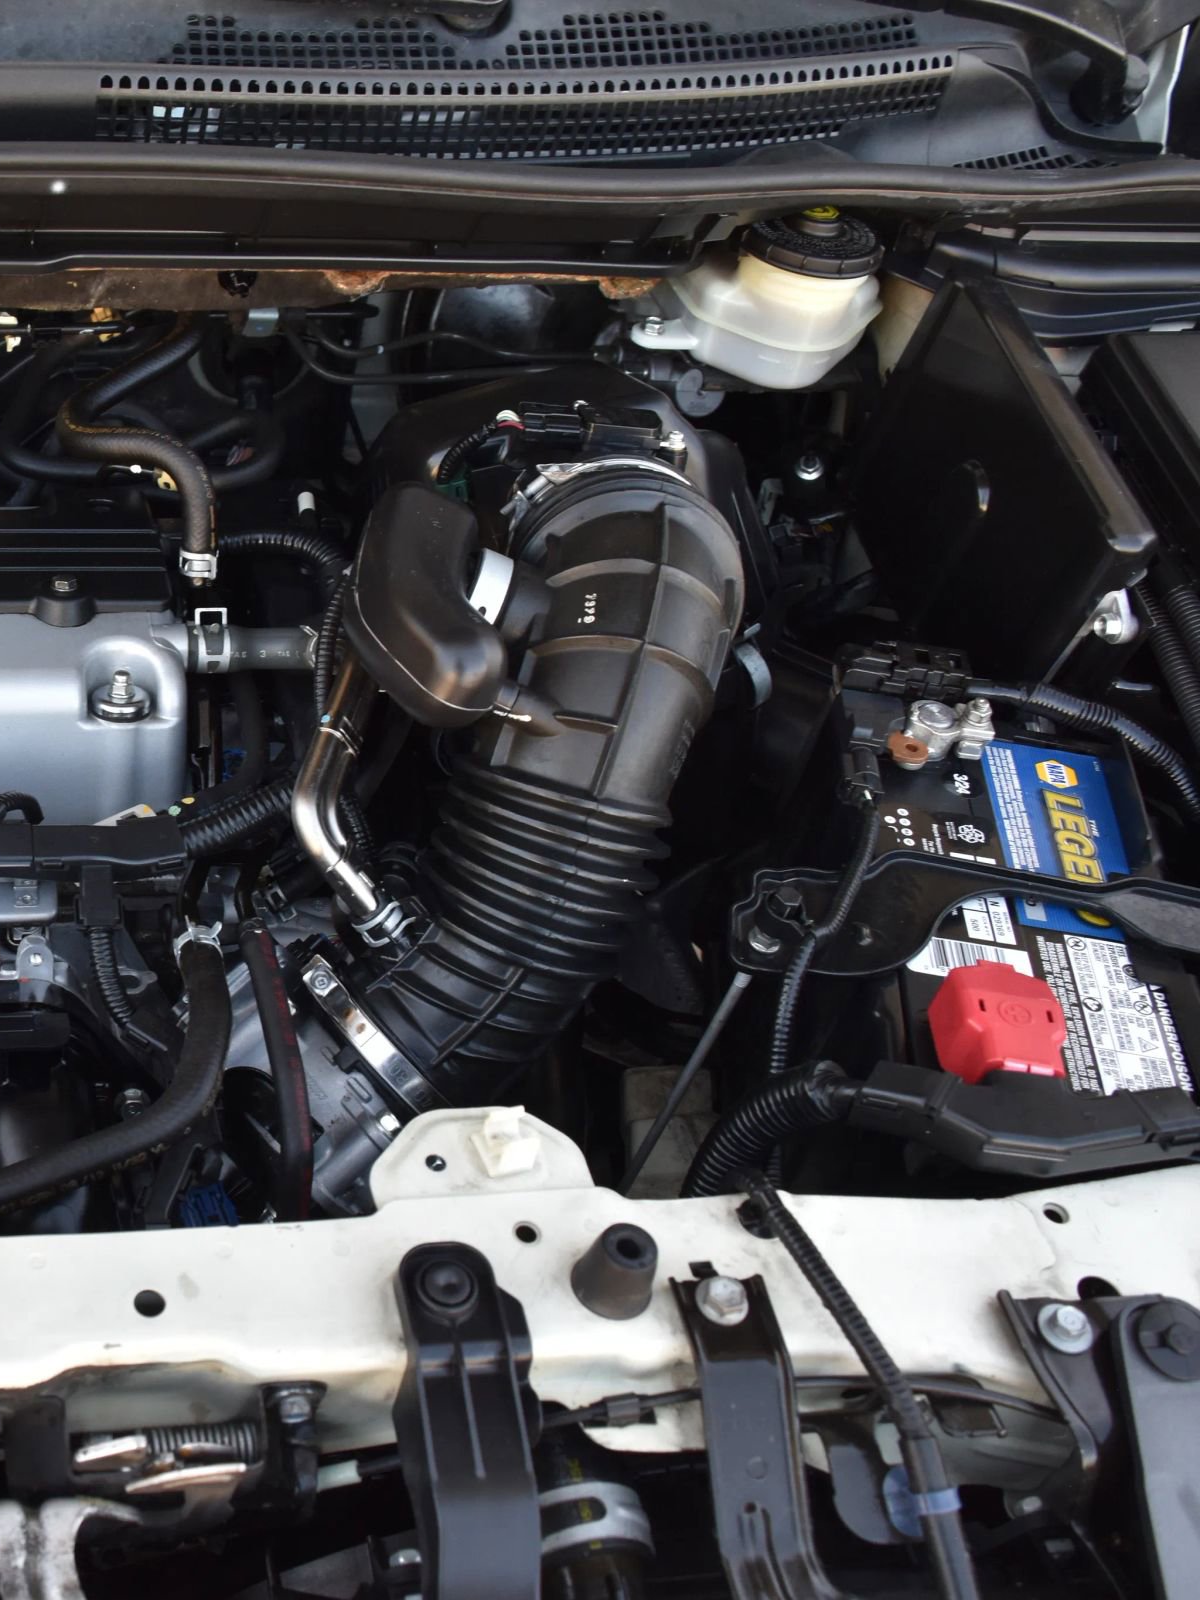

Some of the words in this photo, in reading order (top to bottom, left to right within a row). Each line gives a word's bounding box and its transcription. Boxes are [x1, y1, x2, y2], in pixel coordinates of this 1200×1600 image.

[952, 773, 971, 794] 3/24
[1046, 764, 1066, 784] NAPA
[1043, 789, 1105, 885] LEGE
[1089, 819, 1098, 836] THE
[1153, 992, 1193, 1091] DANGER/POISON
